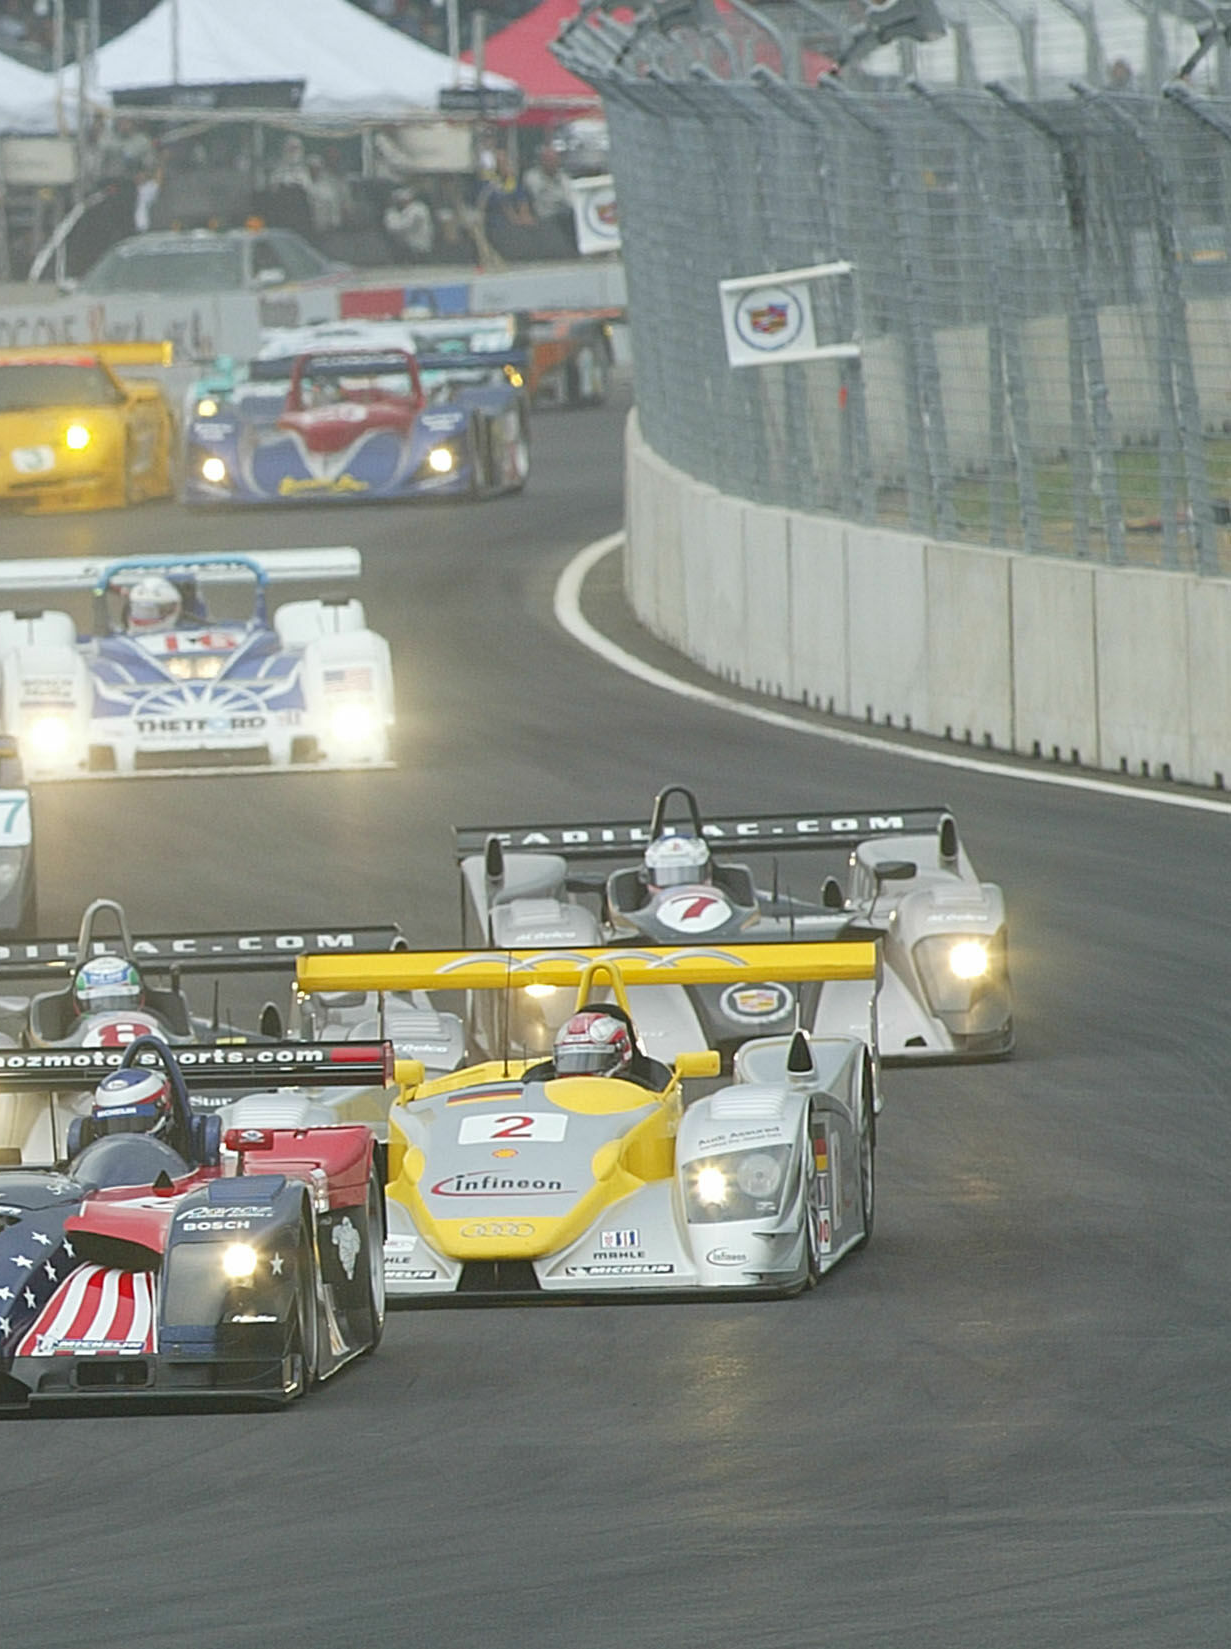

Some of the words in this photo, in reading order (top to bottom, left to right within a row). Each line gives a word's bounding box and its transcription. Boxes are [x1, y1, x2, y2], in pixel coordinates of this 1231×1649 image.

[670, 896, 718, 922] 7
[489, 1115, 535, 1139] 2
[182, 1220, 251, 1231] BOSCH
[593, 1250, 645, 1260] MAHLE
[589, 1264, 672, 1275] MICHELIN
[58, 1340, 144, 1350] MICHELIN
